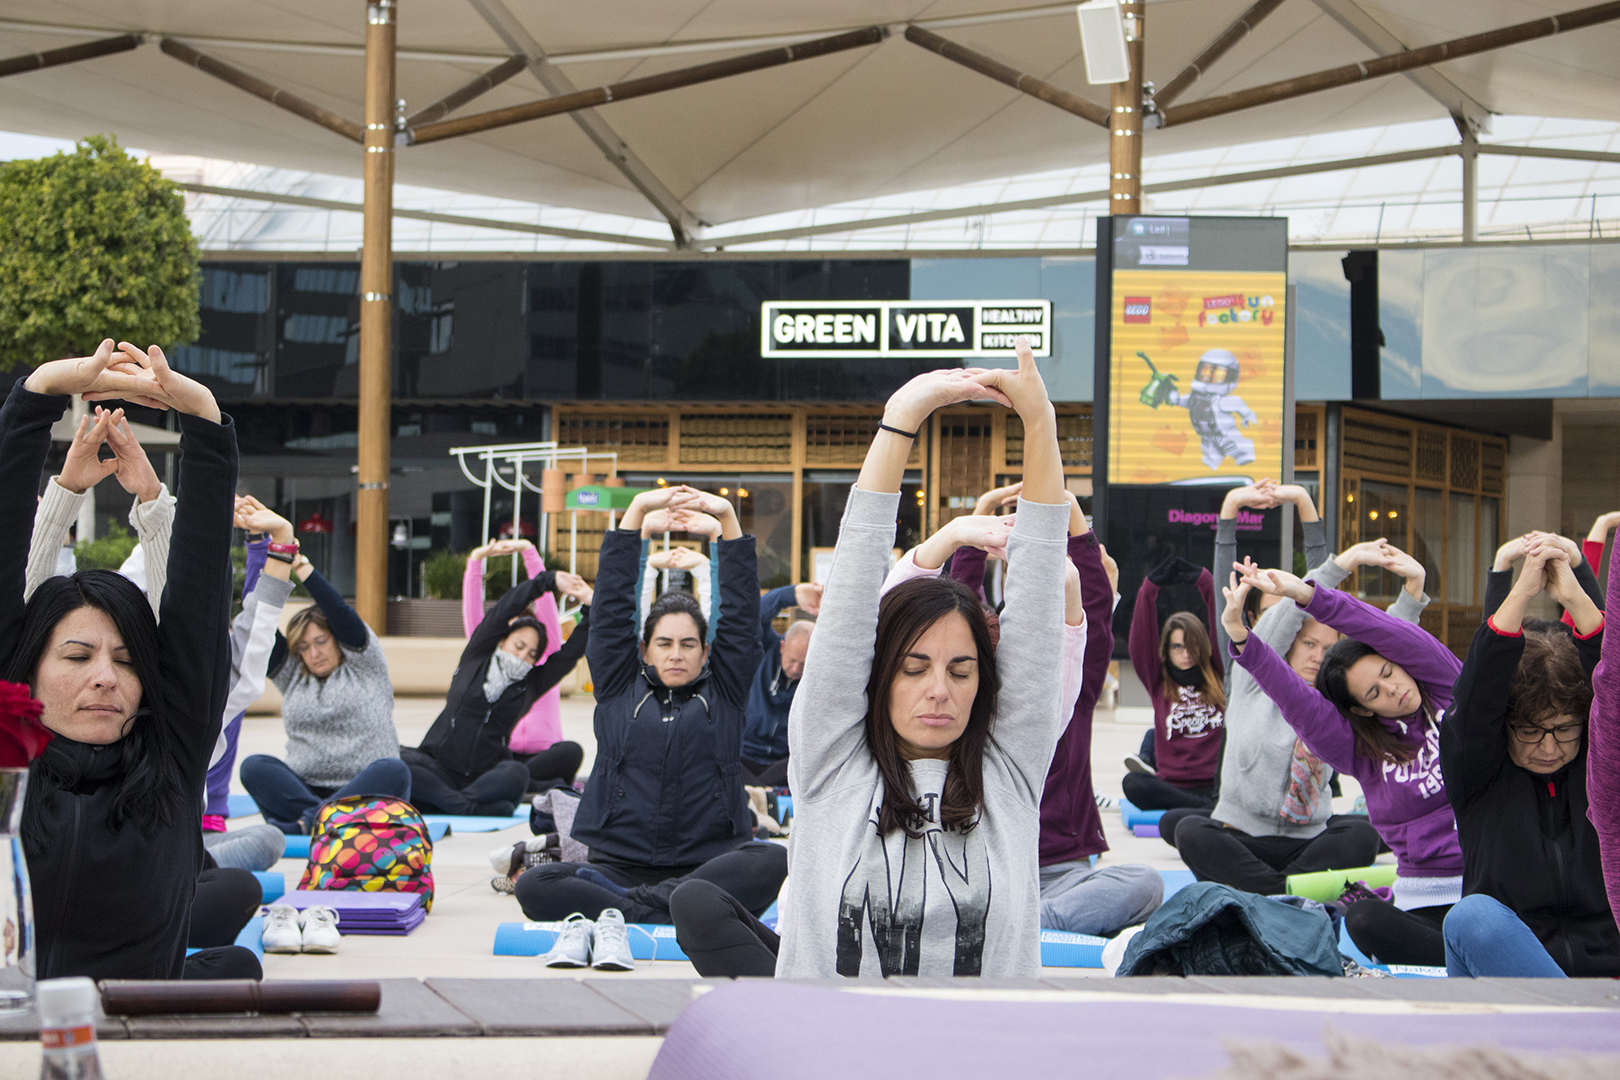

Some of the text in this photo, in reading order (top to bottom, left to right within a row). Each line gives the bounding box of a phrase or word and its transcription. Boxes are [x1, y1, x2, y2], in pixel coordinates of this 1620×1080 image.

[982, 309, 1043, 324] HEALTHY
[1125, 304, 1150, 316] LEGO
[1198, 307, 1274, 328] factory
[773, 314, 966, 343] GREEN VITA
[1236, 511, 1265, 524] Mar
